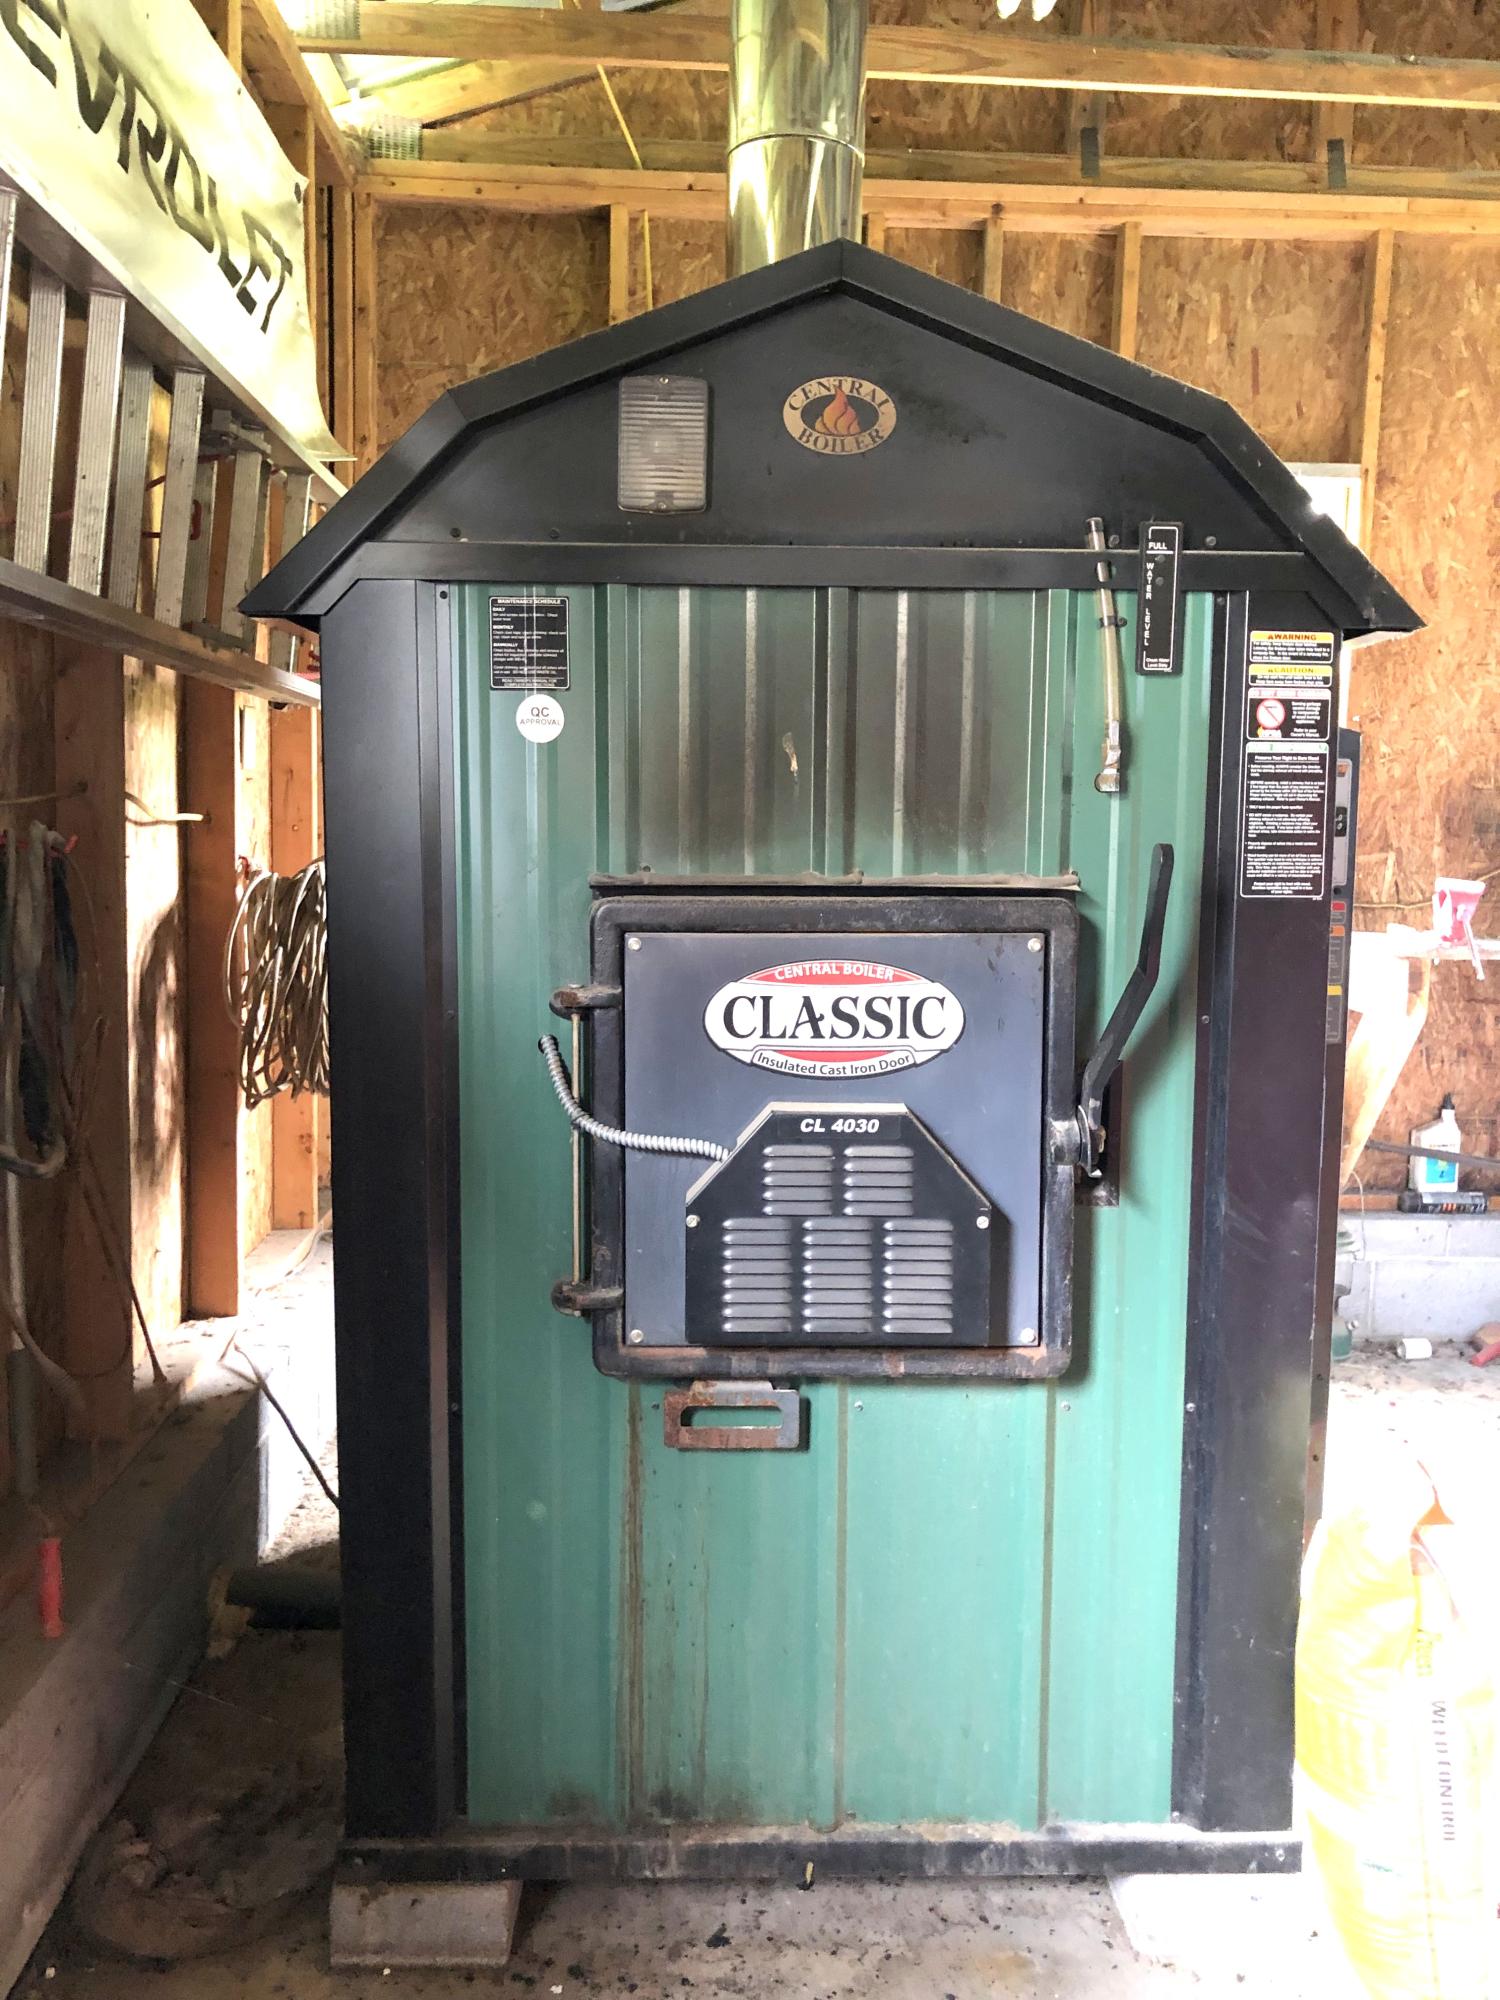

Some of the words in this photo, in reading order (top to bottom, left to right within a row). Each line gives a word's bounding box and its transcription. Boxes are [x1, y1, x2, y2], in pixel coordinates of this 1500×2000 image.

[788, 378, 890, 412] CENTRAL
[798, 428, 884, 453] BOILER
[1148, 541, 1168, 550] FULL
[1145, 562, 1155, 600] WATER
[1143, 608, 1151, 646] LEVEL
[1274, 633, 1317, 641] WARNING
[530, 706, 550, 718] QC
[774, 962, 840, 980] CENTRAL
[843, 963, 894, 981] BOILER
[723, 995, 946, 1039] CLASSIC
[757, 1052, 817, 1075] Insulated
[819, 1064, 847, 1076] Cast
[850, 1063, 876, 1074] Iron
[879, 1054, 911, 1070] Door
[800, 1119, 826, 1133] CL
[831, 1119, 880, 1133] 4030
